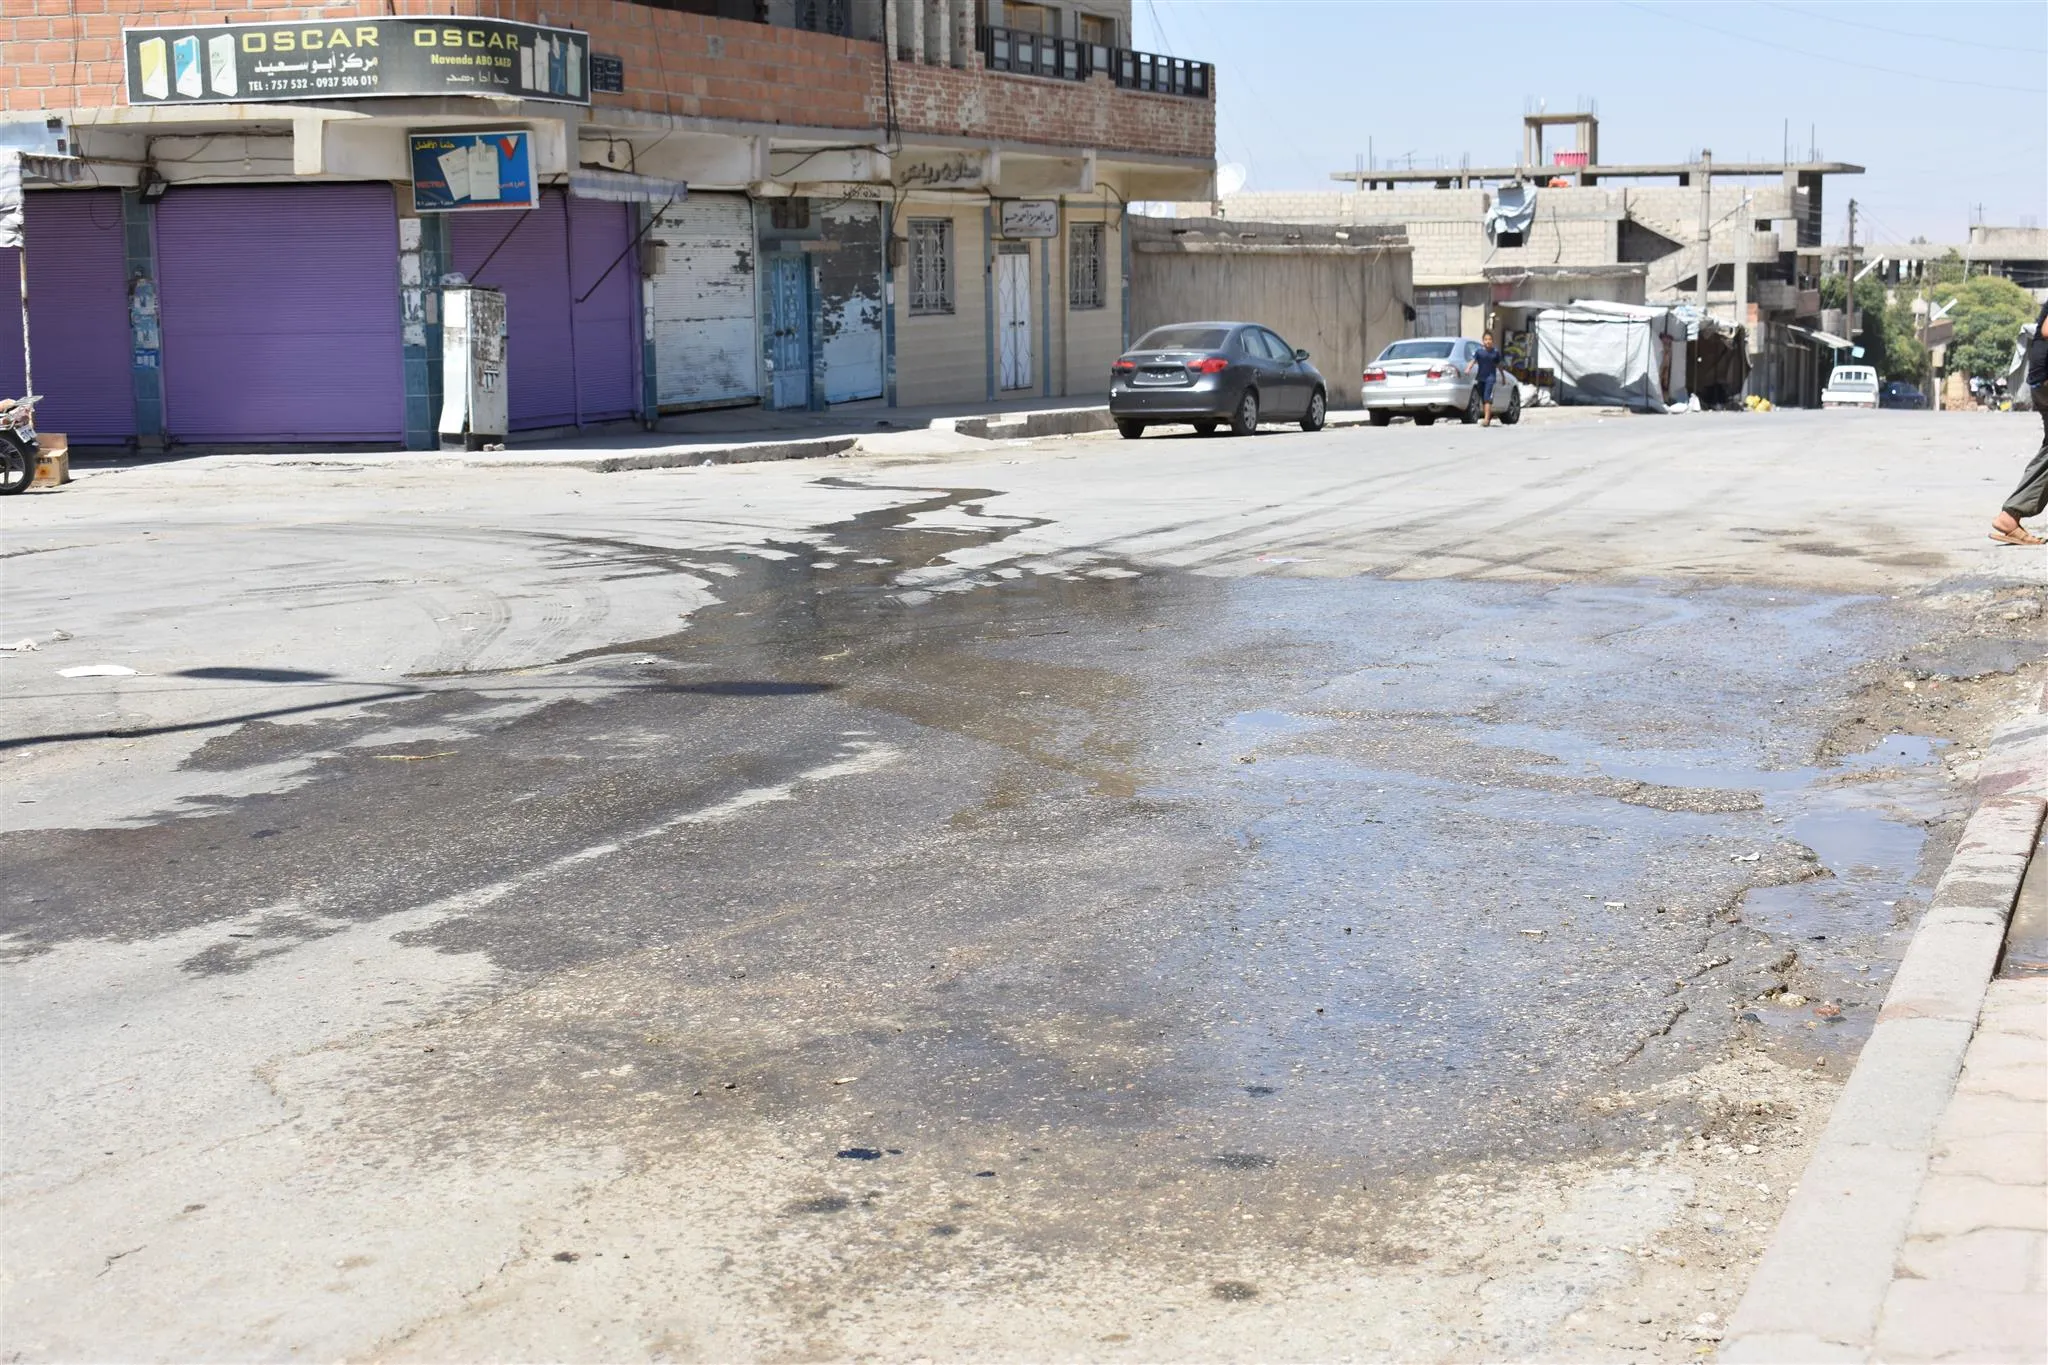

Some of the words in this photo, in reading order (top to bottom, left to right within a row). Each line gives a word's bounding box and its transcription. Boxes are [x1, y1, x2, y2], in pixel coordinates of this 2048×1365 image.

[242, 26, 380, 53] OSCAR
[414, 28, 519, 51] OSCAR
[254, 60, 309, 76] سعيد
[339, 53, 378, 72] مركز
[431, 54, 473, 65] Navenda
[475, 55, 493, 66] ABO
[248, 82, 263, 91] TEL
[271, 80, 288, 90] 757
[291, 79, 308, 89] 532
[316, 78, 339, 87] 0937
[342, 76, 359, 86] 506
[361, 75, 379, 85] 019
